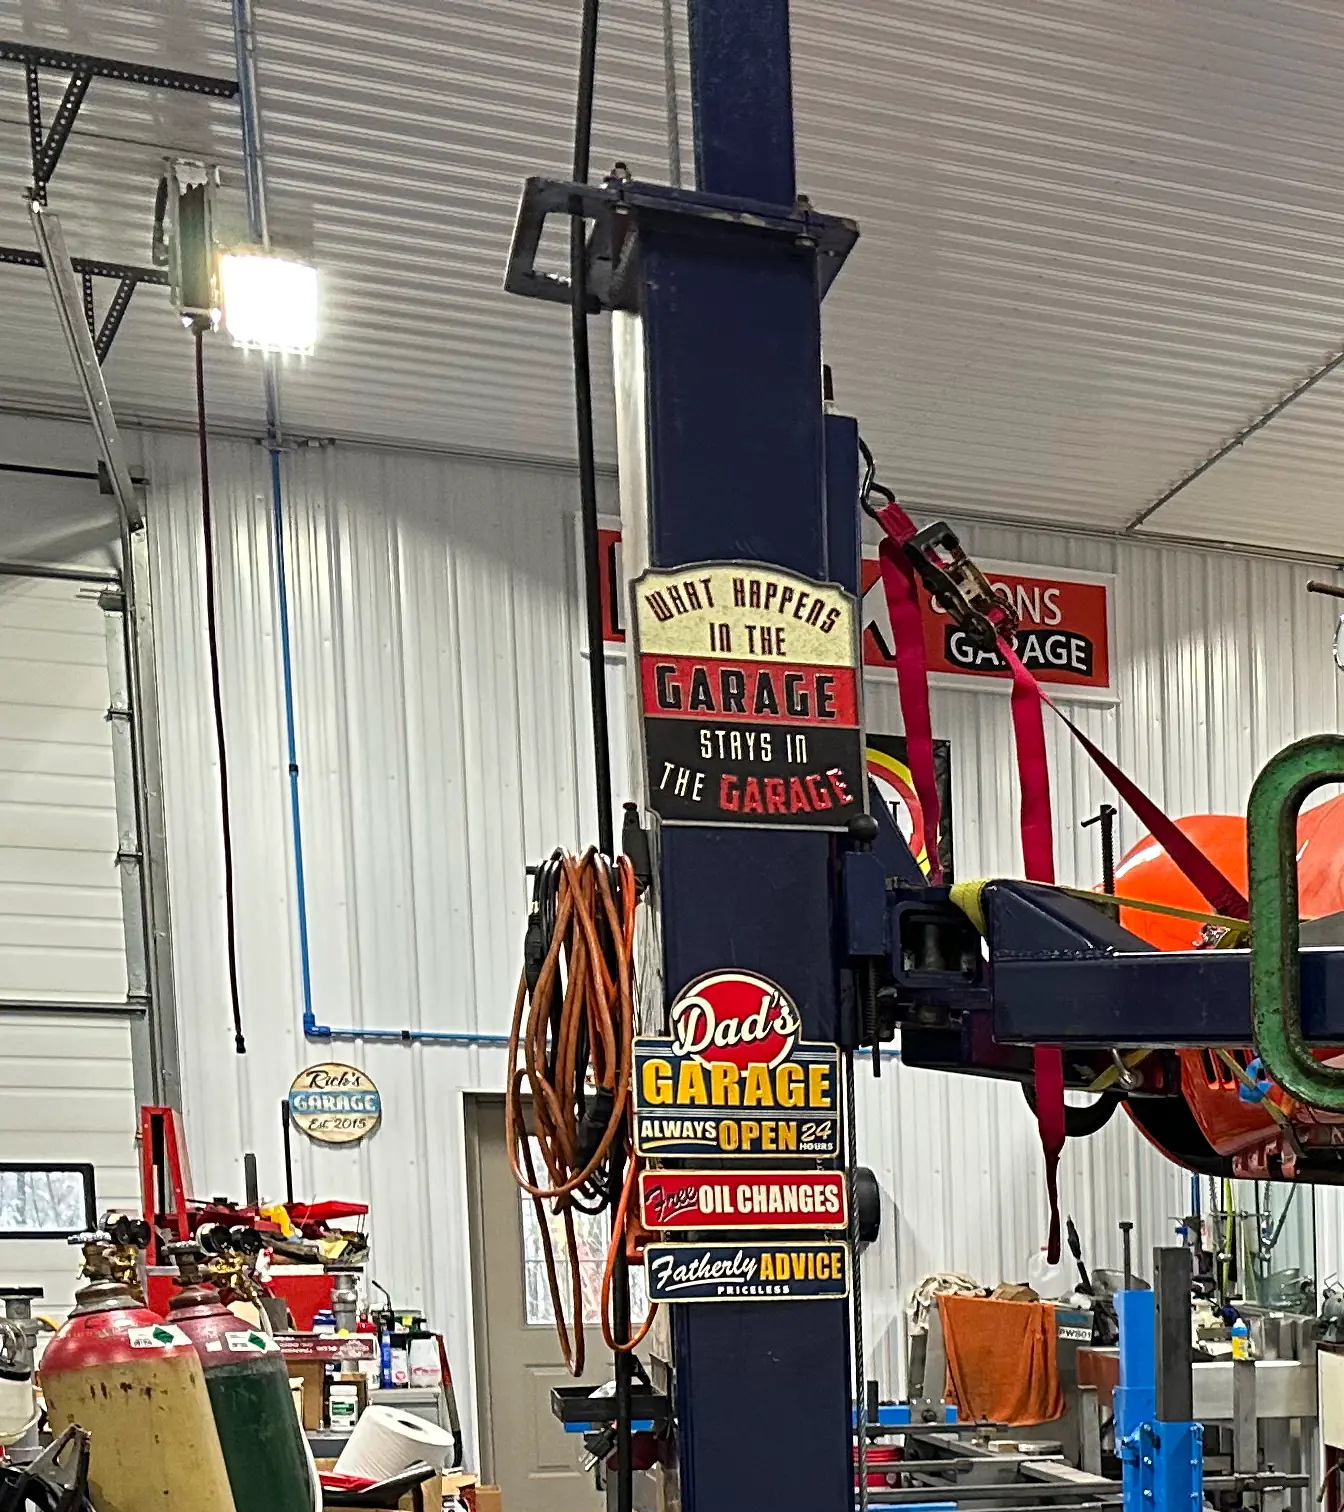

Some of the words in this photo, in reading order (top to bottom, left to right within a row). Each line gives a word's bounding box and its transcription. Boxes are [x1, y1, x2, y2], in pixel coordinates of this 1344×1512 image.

[644, 576, 718, 623] WHAT
[732, 576, 841, 634] HAPPENS
[709, 622, 731, 653] IN
[745, 625, 787, 657] THE
[950, 631, 1087, 670] GAAGE
[655, 663, 837, 719] GARAGE
[699, 728, 773, 763] STAYS
[786, 733, 808, 765] IN
[659, 760, 705, 802] THE
[719, 767, 854, 816] GARAGE
[671, 989, 800, 1057] Dad's
[306, 1070, 361, 1090] Rich's
[642, 1058, 831, 1108] GARAGE
[293, 1094, 376, 1111] GARAGE
[334, 1118, 367, 1129] 2015
[640, 1118, 717, 1139] ALWAYS
[718, 1120, 797, 1151] OPEN
[801, 1121, 832, 1140] 24
[799, 1142, 834, 1151] HOURS
[700, 1184, 735, 1214] OIL
[738, 1184, 839, 1214] CHANGES
[652, 1250, 758, 1290] Fatherly
[760, 1253, 842, 1281] ADVICE
[717, 1285, 790, 1295] PRICELESS
